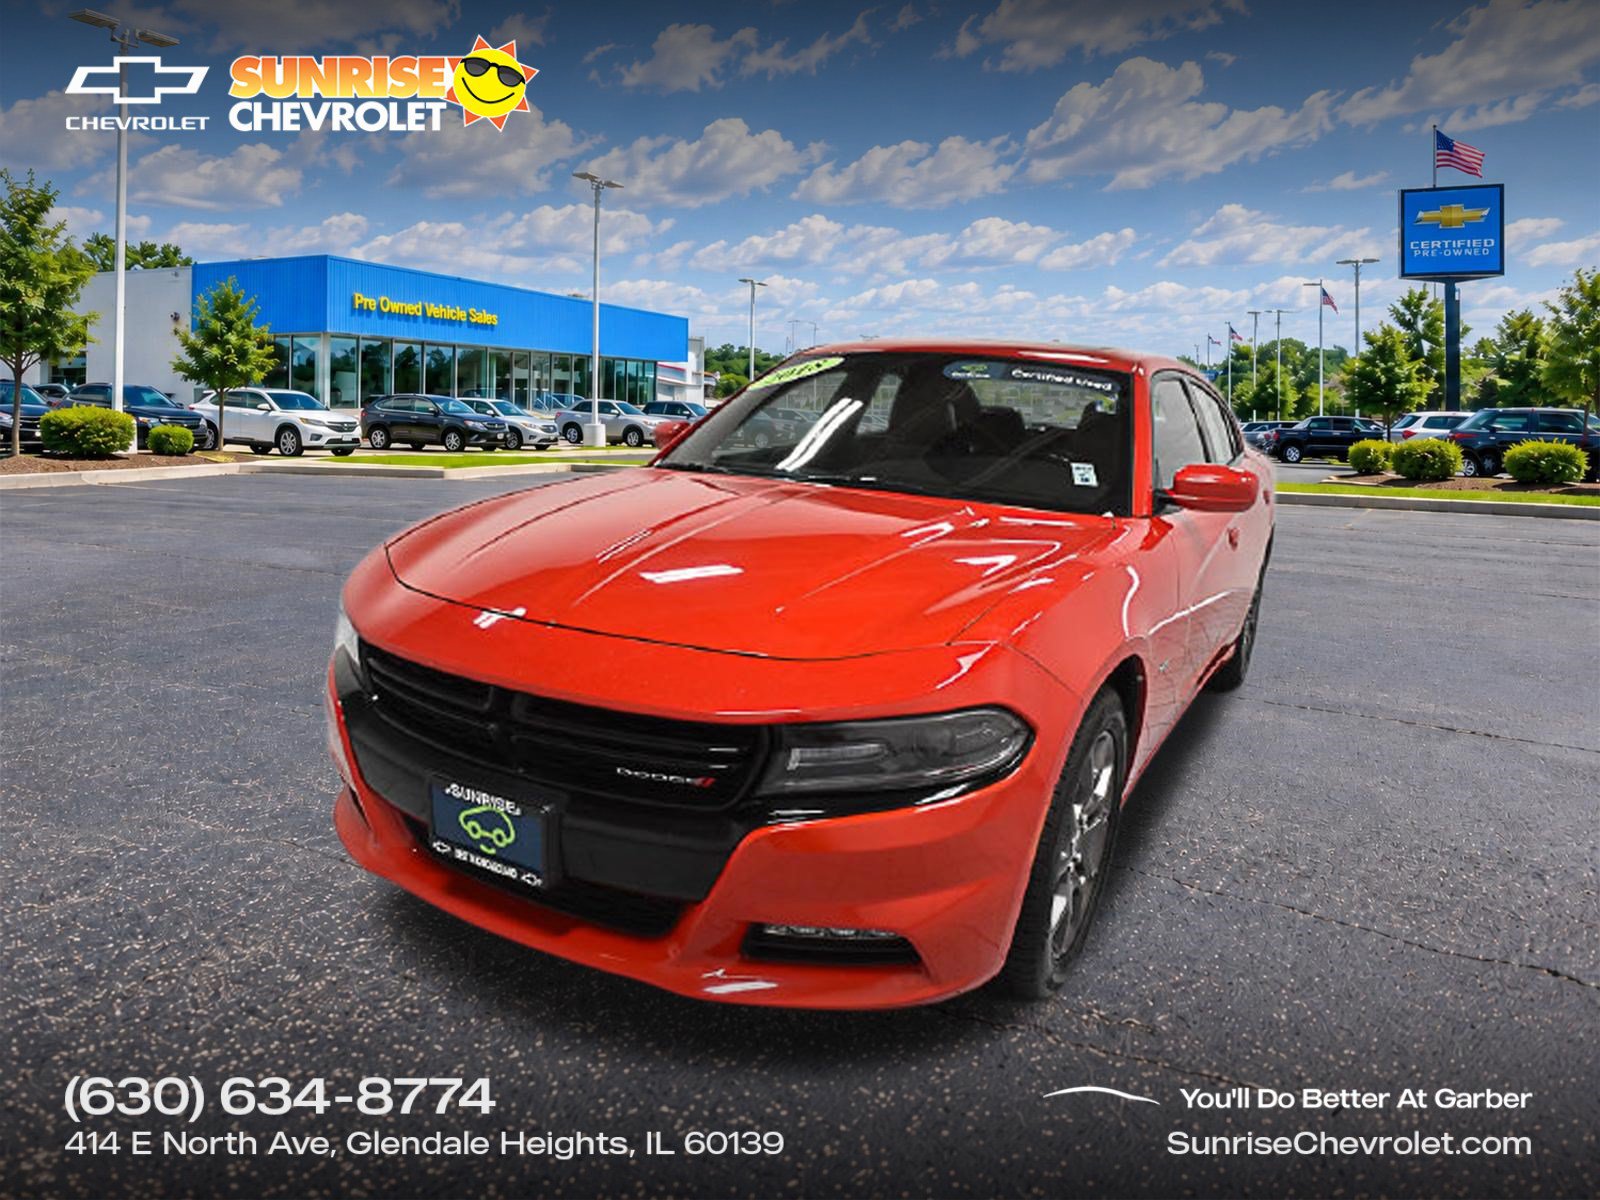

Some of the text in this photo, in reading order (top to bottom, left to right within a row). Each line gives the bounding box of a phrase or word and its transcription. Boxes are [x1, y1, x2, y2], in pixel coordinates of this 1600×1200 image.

[1410, 238, 1495, 250] CERTIFIED
[1413, 247, 1490, 257] PRE-OWNED
[353, 292, 498, 325] Pre Owned Vehicle Sales
[616, 767, 694, 784] DODGE
[450, 783, 516, 814] SUNRISE
